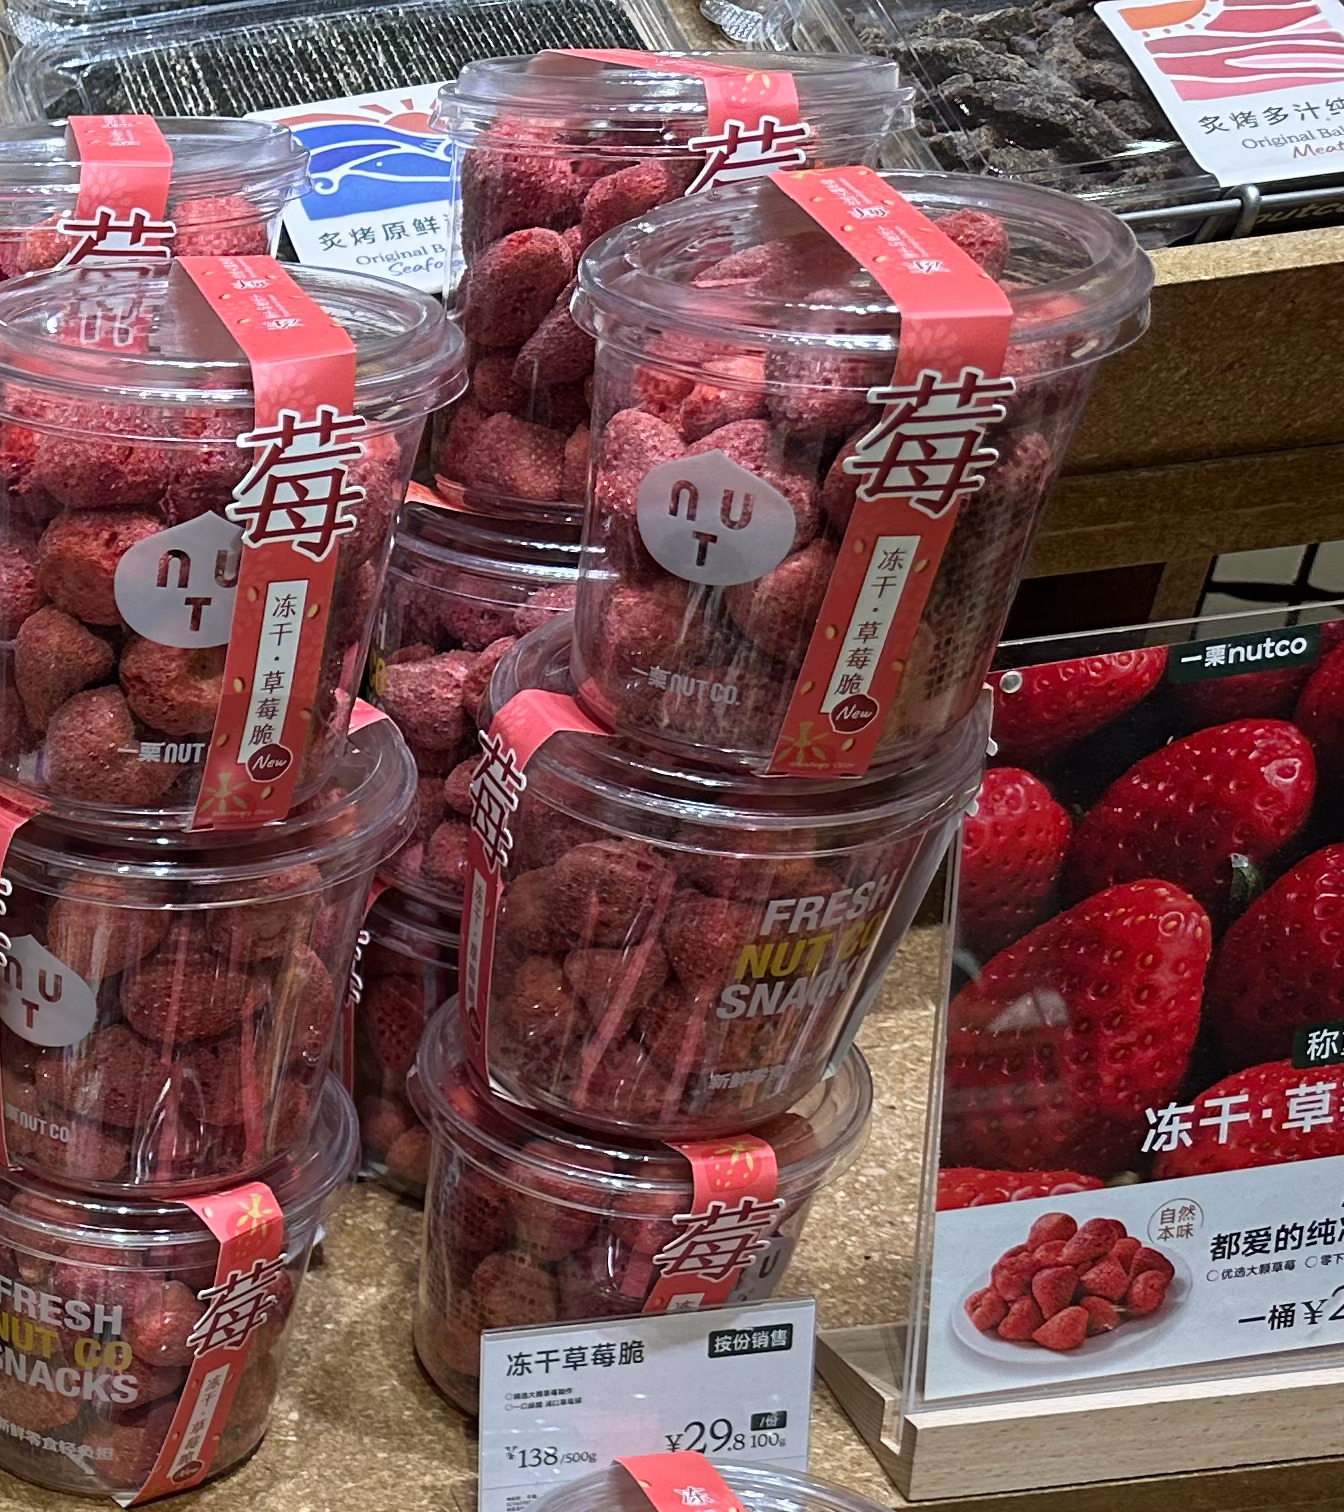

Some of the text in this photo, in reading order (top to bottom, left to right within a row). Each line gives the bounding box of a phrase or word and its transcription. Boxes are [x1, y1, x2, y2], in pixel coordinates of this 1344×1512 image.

[1242, 130, 1315, 150] Original
[356, 248, 429, 266] Original
[844, 367, 1015, 517] 莓
[226, 406, 365, 562] 莓
[835, 703, 874, 726] New
[164, 742, 205, 764] NUT
[252, 752, 290, 772] New
[759, 868, 898, 937] FRESH
[734, 936, 832, 980] NUT
[1141, 1081, 1344, 1154] 冻干·草
[1159, 1204, 1197, 1225] 自然
[653, 1197, 786, 1283] 莓
[1157, 1222, 1194, 1242] 本味
[1221, 1259, 1297, 1281] 优选大颗草莓
[186, 1253, 289, 1358] 莓
[74, 1335, 134, 1373] CO
[713, 1329, 789, 1353] 按份销售
[506, 1340, 645, 1377] 冻干草莓脆
